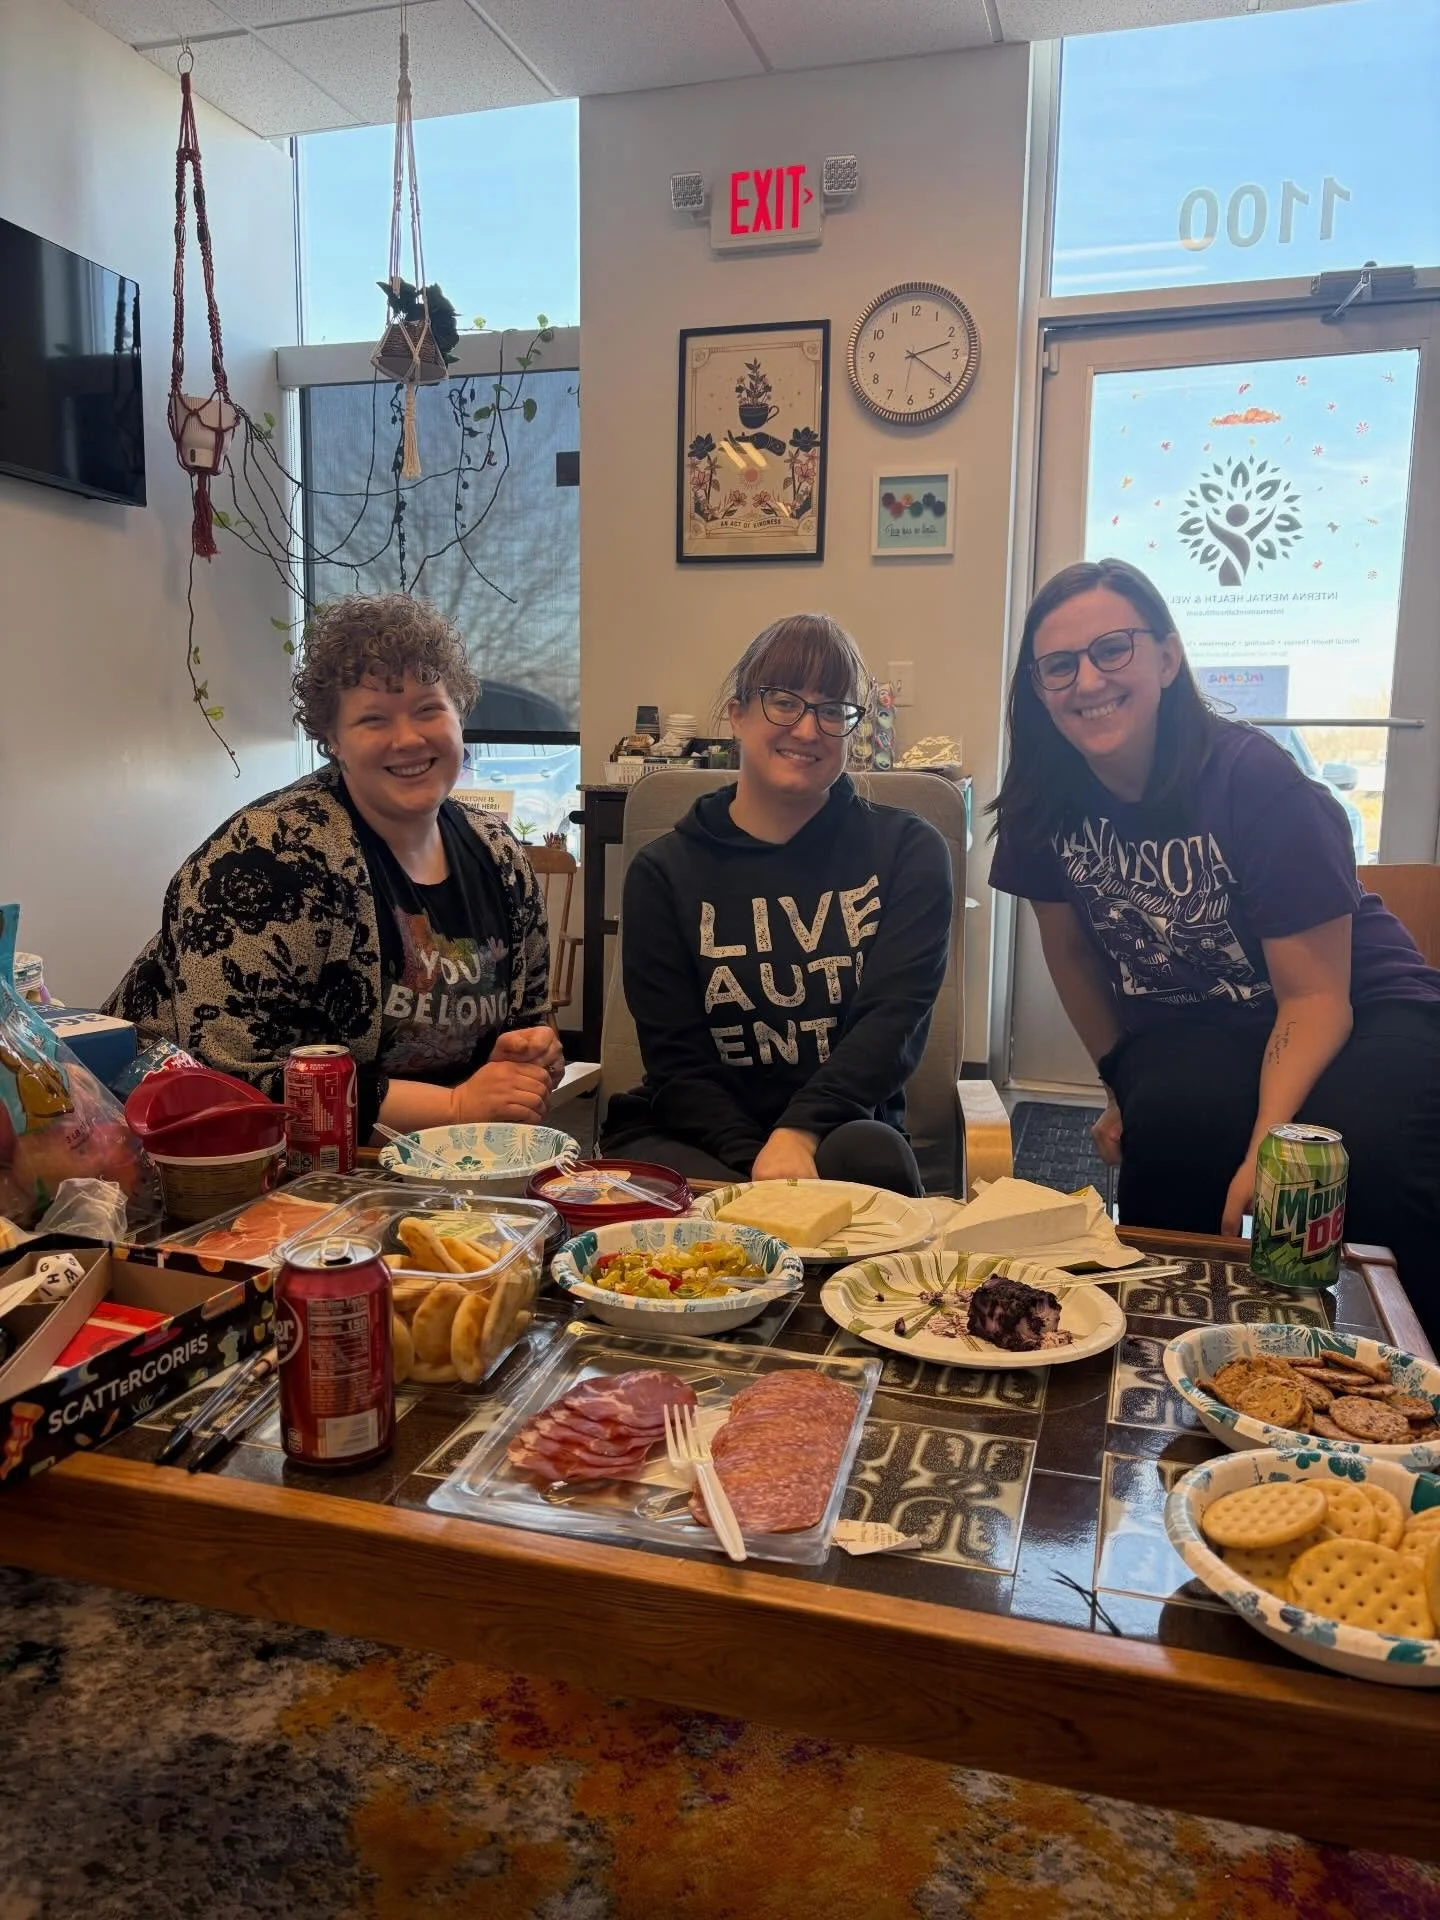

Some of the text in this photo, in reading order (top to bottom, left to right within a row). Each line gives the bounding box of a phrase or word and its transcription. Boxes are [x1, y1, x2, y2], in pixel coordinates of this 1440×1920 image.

[730, 165, 806, 235] EXIT
[911, 305, 921, 317] 12
[891, 312, 898, 324] 11
[873, 329, 885, 341] 10
[947, 326, 956, 338] 2
[868, 351, 875, 363] 9
[952, 348, 960, 360] 3
[872, 373, 880, 385] 8
[944, 371, 952, 383] 4
[887, 389, 894, 401] 7
[906, 394, 914, 406] 6
[928, 388, 935, 400] 5
[753, 519, 781, 529] KINDNESS
[700, 874, 881, 959] LIVE
[420, 949, 482, 985] YOU
[40, 1263, 49, 1272] G
